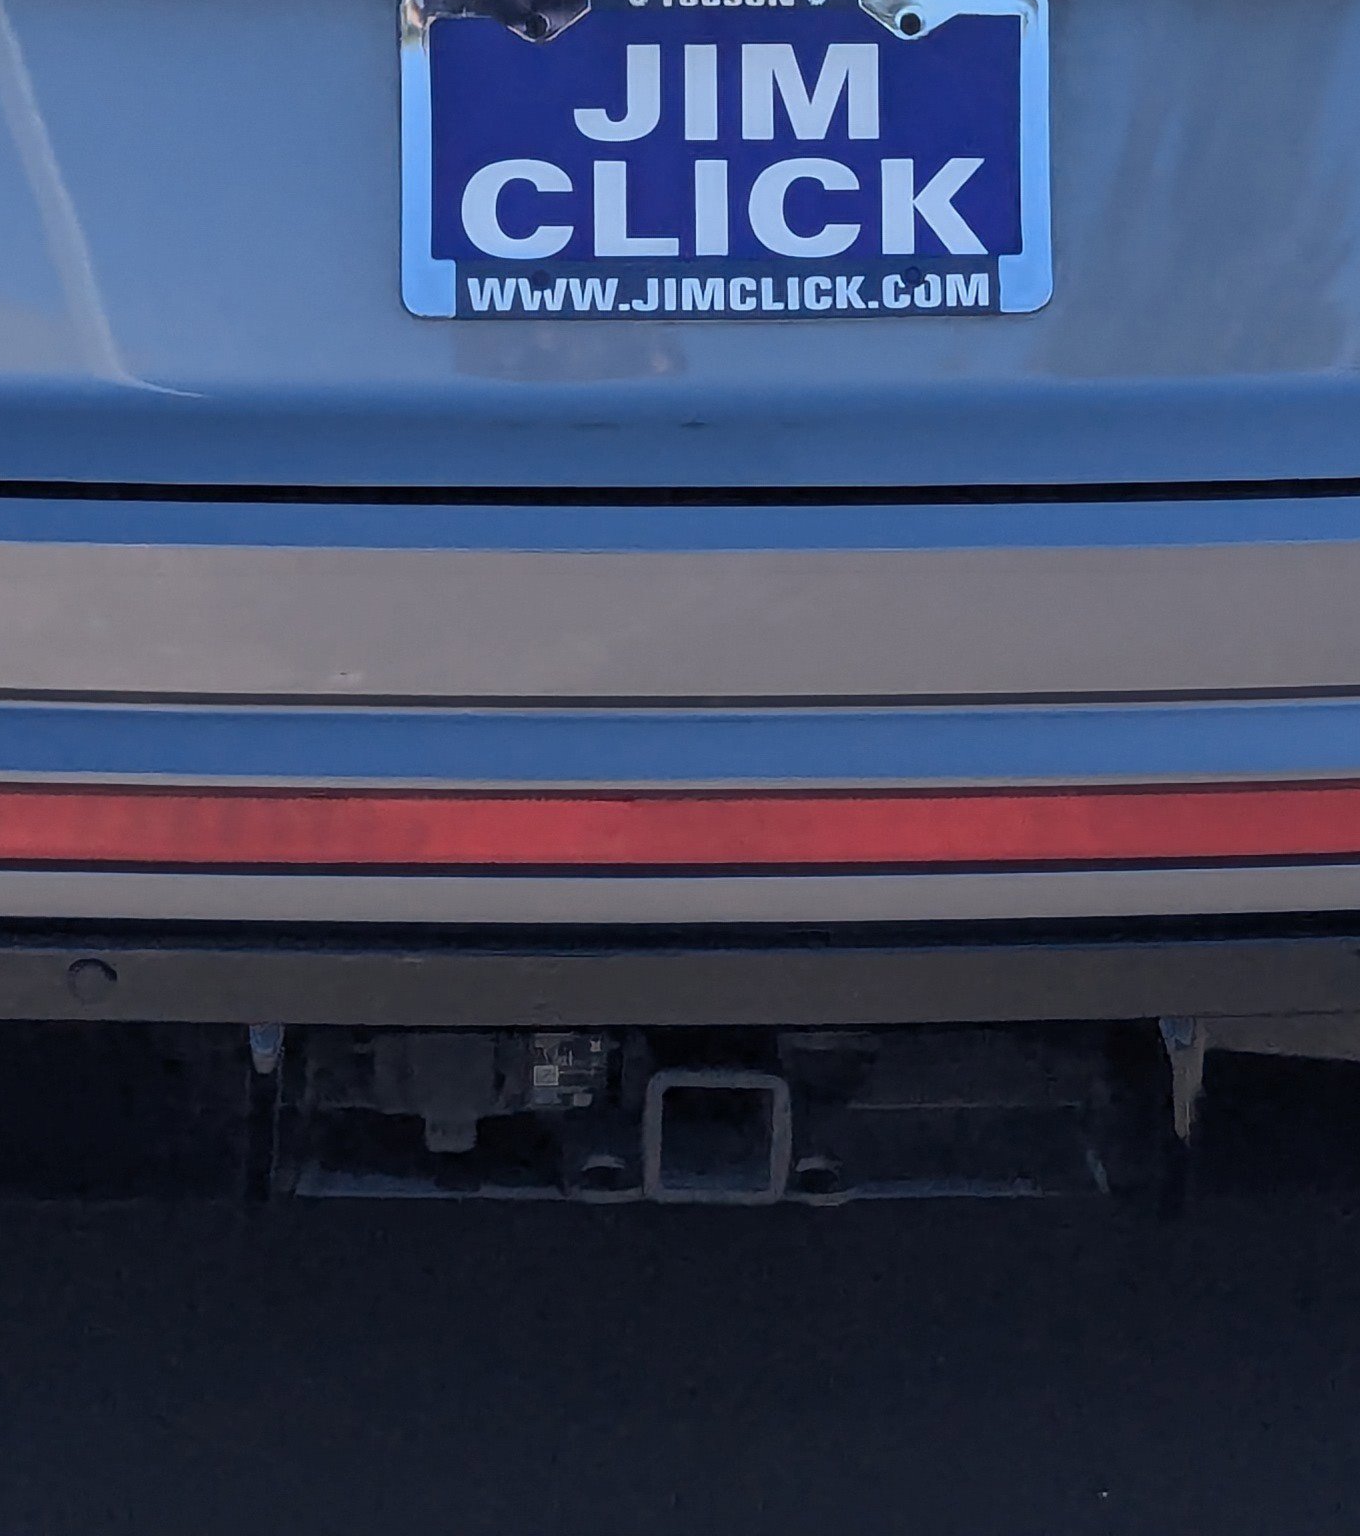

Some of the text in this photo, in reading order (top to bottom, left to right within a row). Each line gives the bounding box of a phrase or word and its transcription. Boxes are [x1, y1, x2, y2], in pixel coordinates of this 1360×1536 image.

[574, 43, 880, 142] JIM
[461, 158, 989, 258] CLICK
[467, 273, 990, 312] WWW.JIMCLICK.COM
